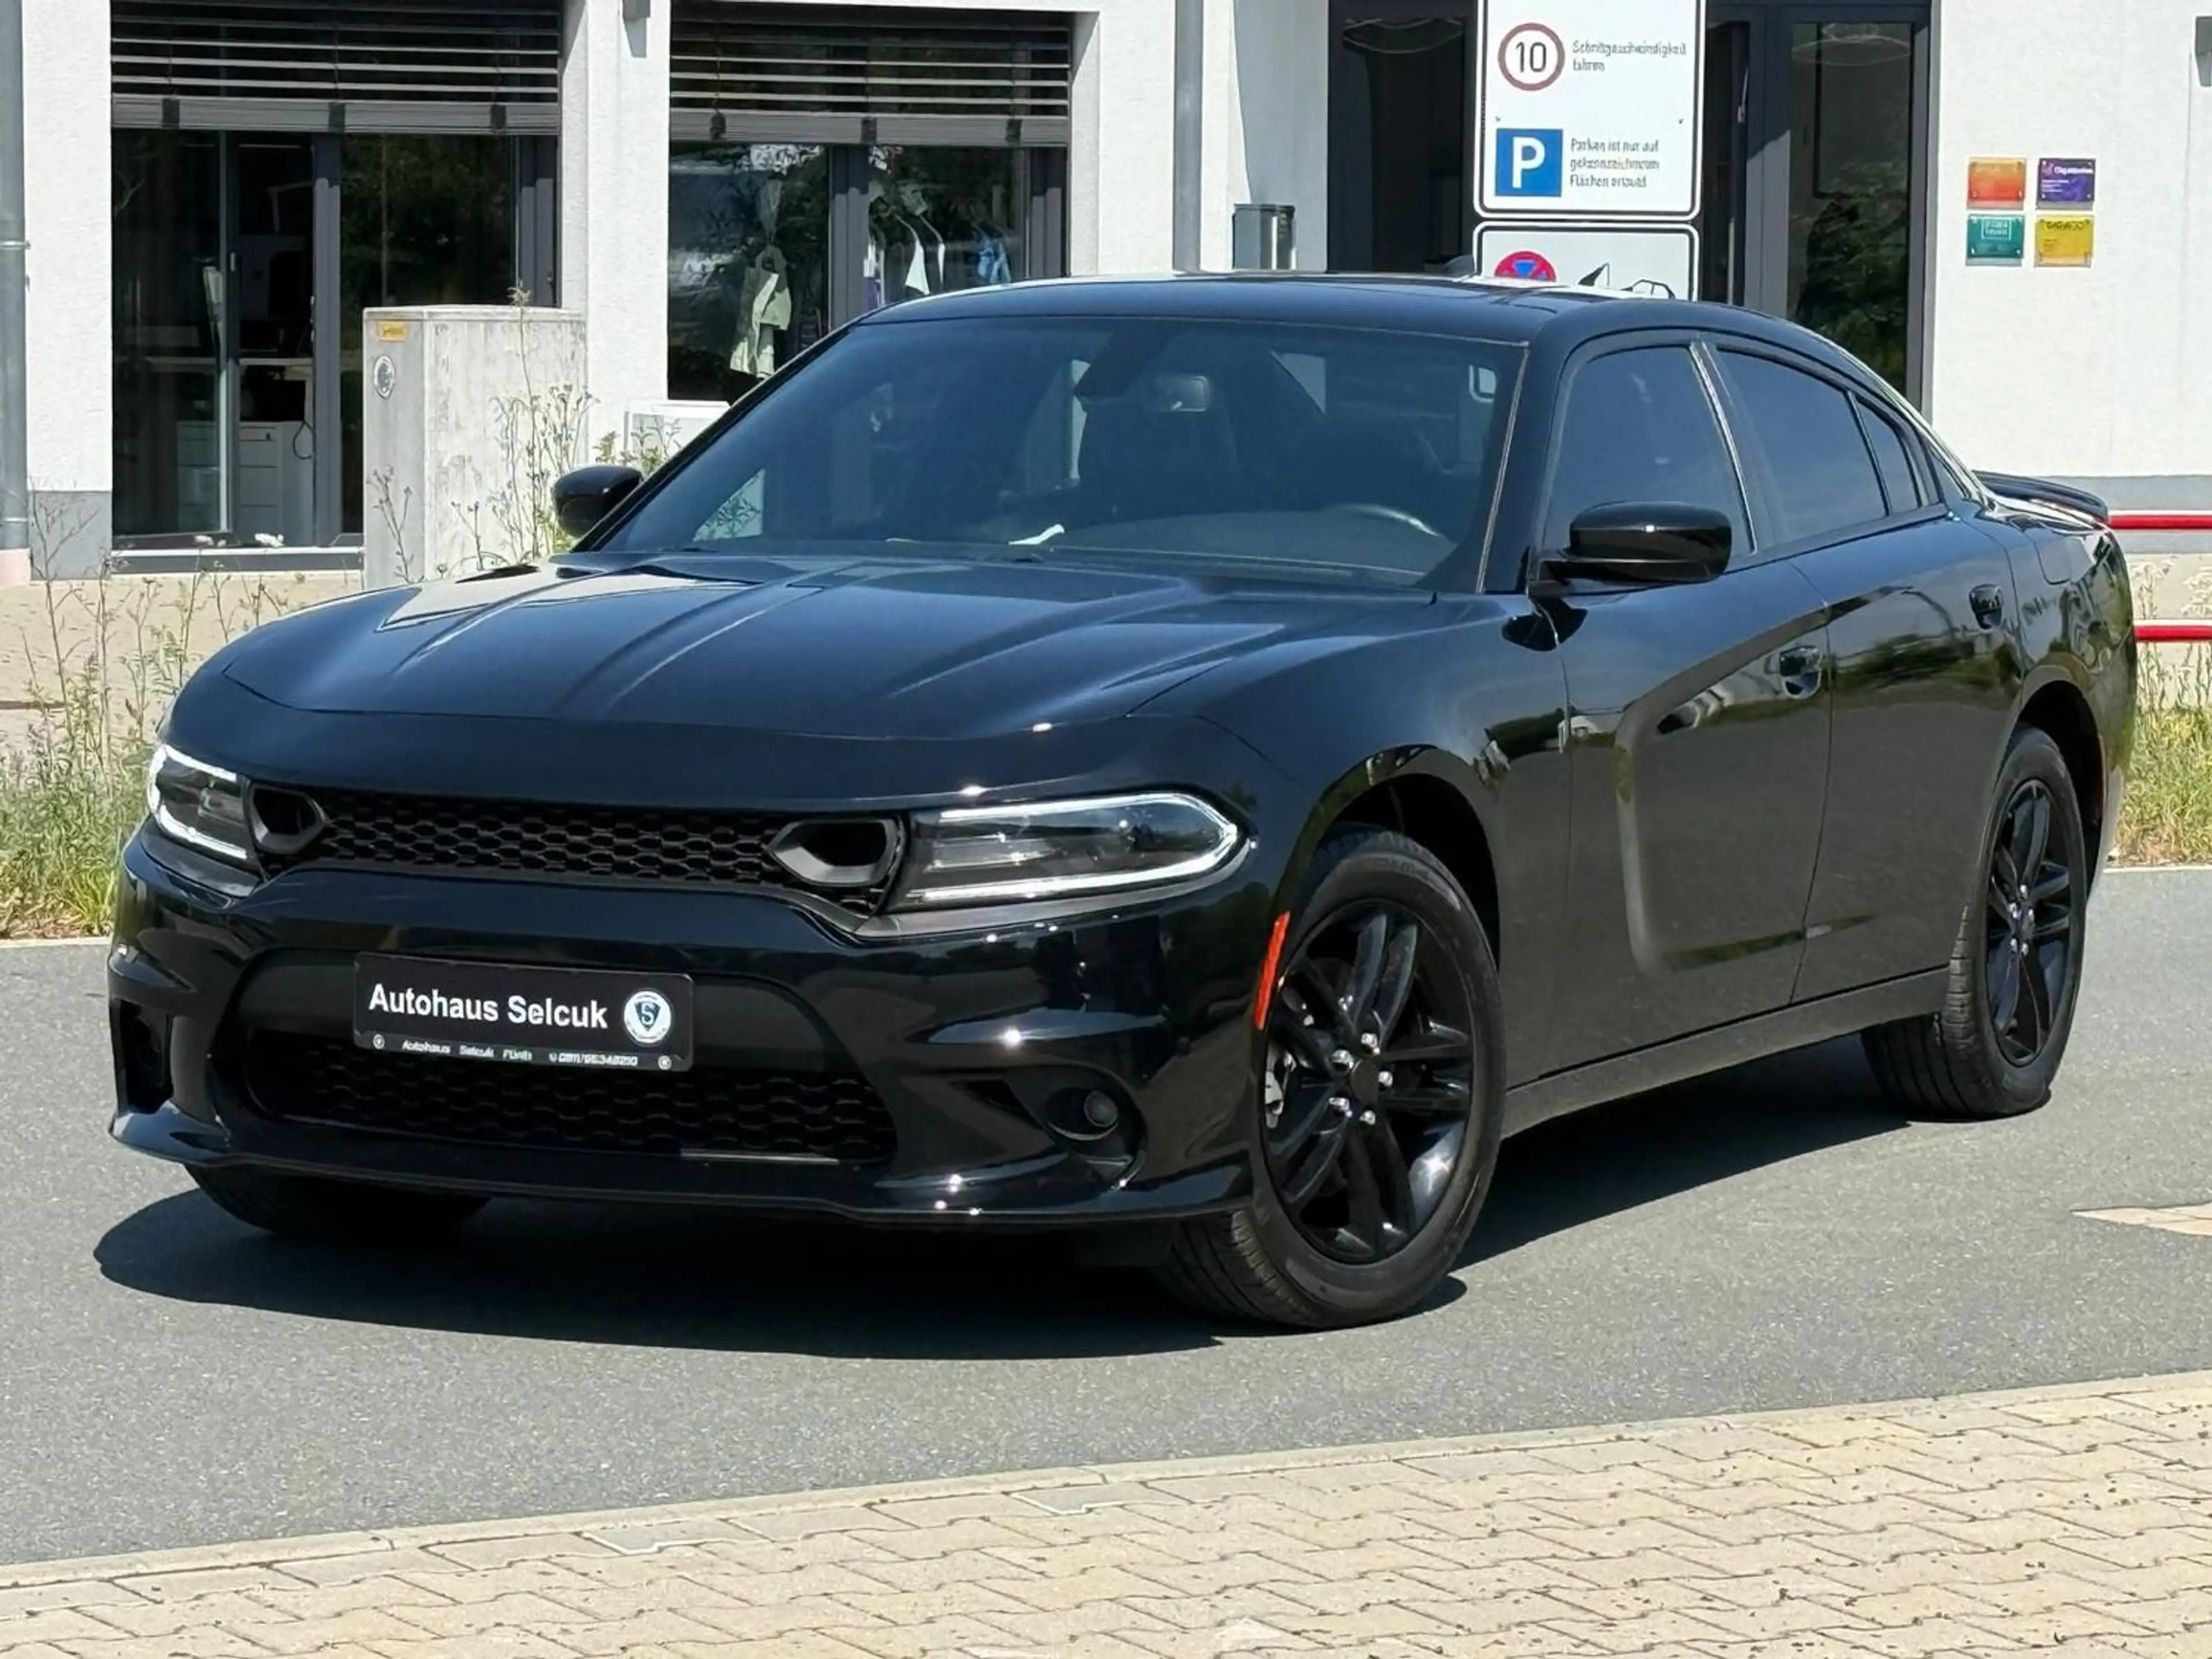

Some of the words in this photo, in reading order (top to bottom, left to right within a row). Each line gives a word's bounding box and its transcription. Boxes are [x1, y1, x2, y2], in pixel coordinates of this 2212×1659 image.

[1516, 41, 1547, 73] 10
[1512, 137, 1545, 189] P
[1571, 138, 1605, 152] Parken
[1622, 141, 1640, 152] nur
[1642, 139, 1659, 153] auf
[369, 983, 499, 1021] Autohaus
[507, 995, 608, 1029] Selcuk
